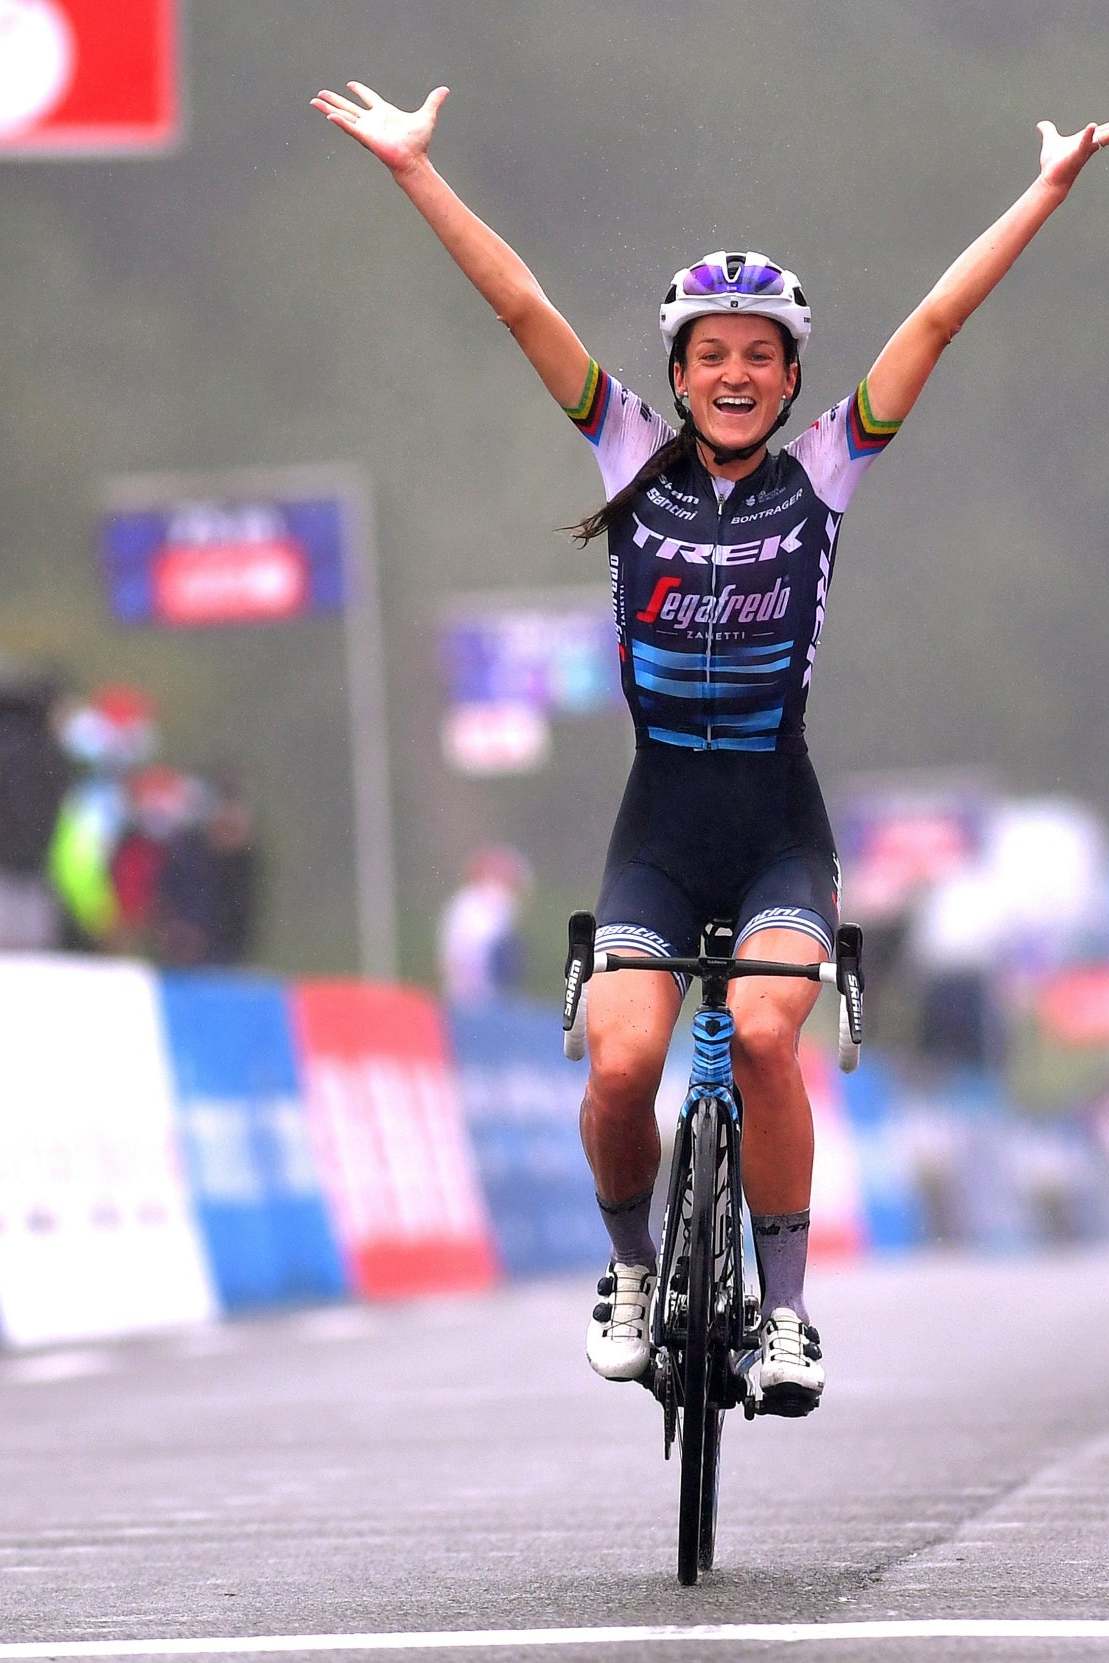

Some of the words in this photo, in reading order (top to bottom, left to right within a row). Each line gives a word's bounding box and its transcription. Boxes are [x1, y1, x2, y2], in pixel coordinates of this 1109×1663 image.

[730, 487, 803, 524] BONTRAGER
[632, 512, 808, 566] TREK
[635, 576, 791, 629] Segafredo
[564, 959, 582, 1017] SRAM
